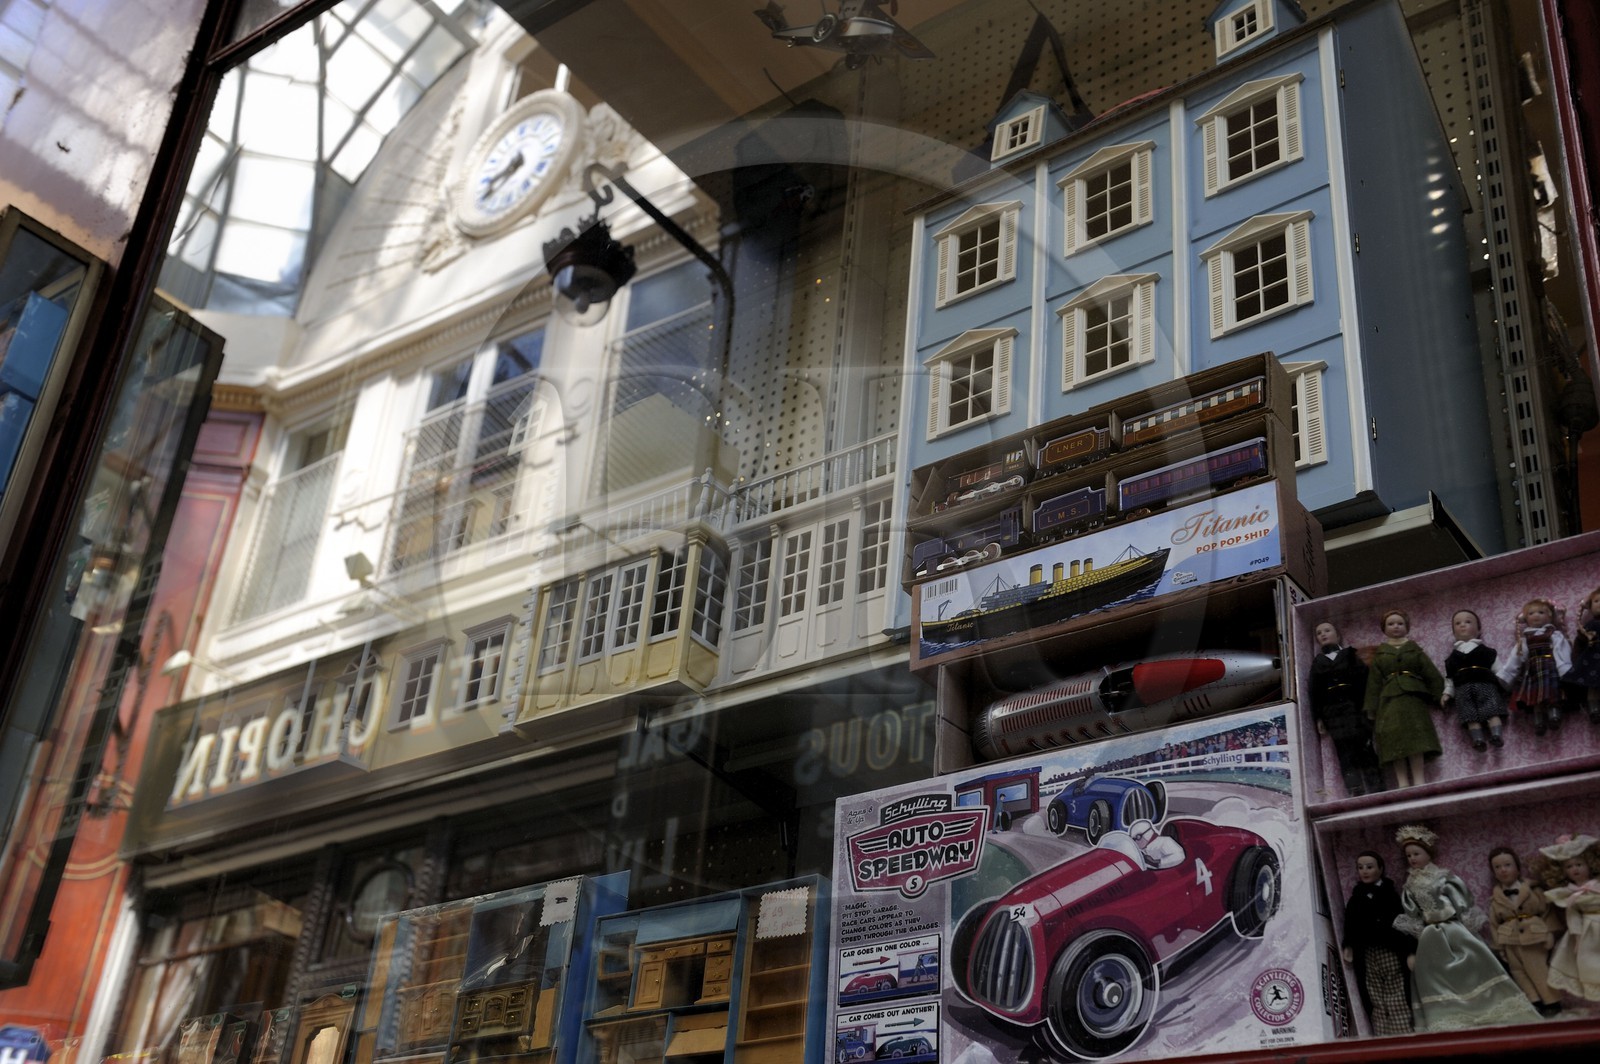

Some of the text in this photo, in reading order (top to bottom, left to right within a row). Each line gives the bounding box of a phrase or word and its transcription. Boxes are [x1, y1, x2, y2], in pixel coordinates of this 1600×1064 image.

[1056, 439, 1084, 454] LNER
[1170, 505, 1270, 545] Titanic
[1196, 528, 1270, 555] POP POP SHIP
[1250, 556, 1270, 566] #P049
[1203, 753, 1243, 766] Schylling
[885, 797, 947, 820] Schylling
[888, 822, 944, 850] AUTO
[858, 841, 974, 880] SPEEDWAY
[1194, 857, 1213, 896] 4
[842, 919, 857, 927] RACE
[860, 917, 875, 925] CARS
[877, 912, 903, 921] APPEAR
[1011, 906, 1026, 921] 54
[841, 926, 866, 935] CHANGE
[868, 922, 893, 931] COLORS
[841, 935, 861, 943] SPEED
[864, 930, 893, 940] THROUGH
[909, 922, 940, 932] GARAGES.
[843, 950, 855, 958] CAR
[857, 948, 874, 956] GOES
[884, 944, 897, 952] ONE
[900, 940, 921, 949] COLOR
[1255, 971, 1297, 991] SCHYLLING
[863, 1012, 885, 1020] COMES
[887, 1009, 900, 1017] OUT
[902, 1005, 935, 1015] ANOTHER!
[1254, 992, 1300, 1021] COLLECTOR SERIES
